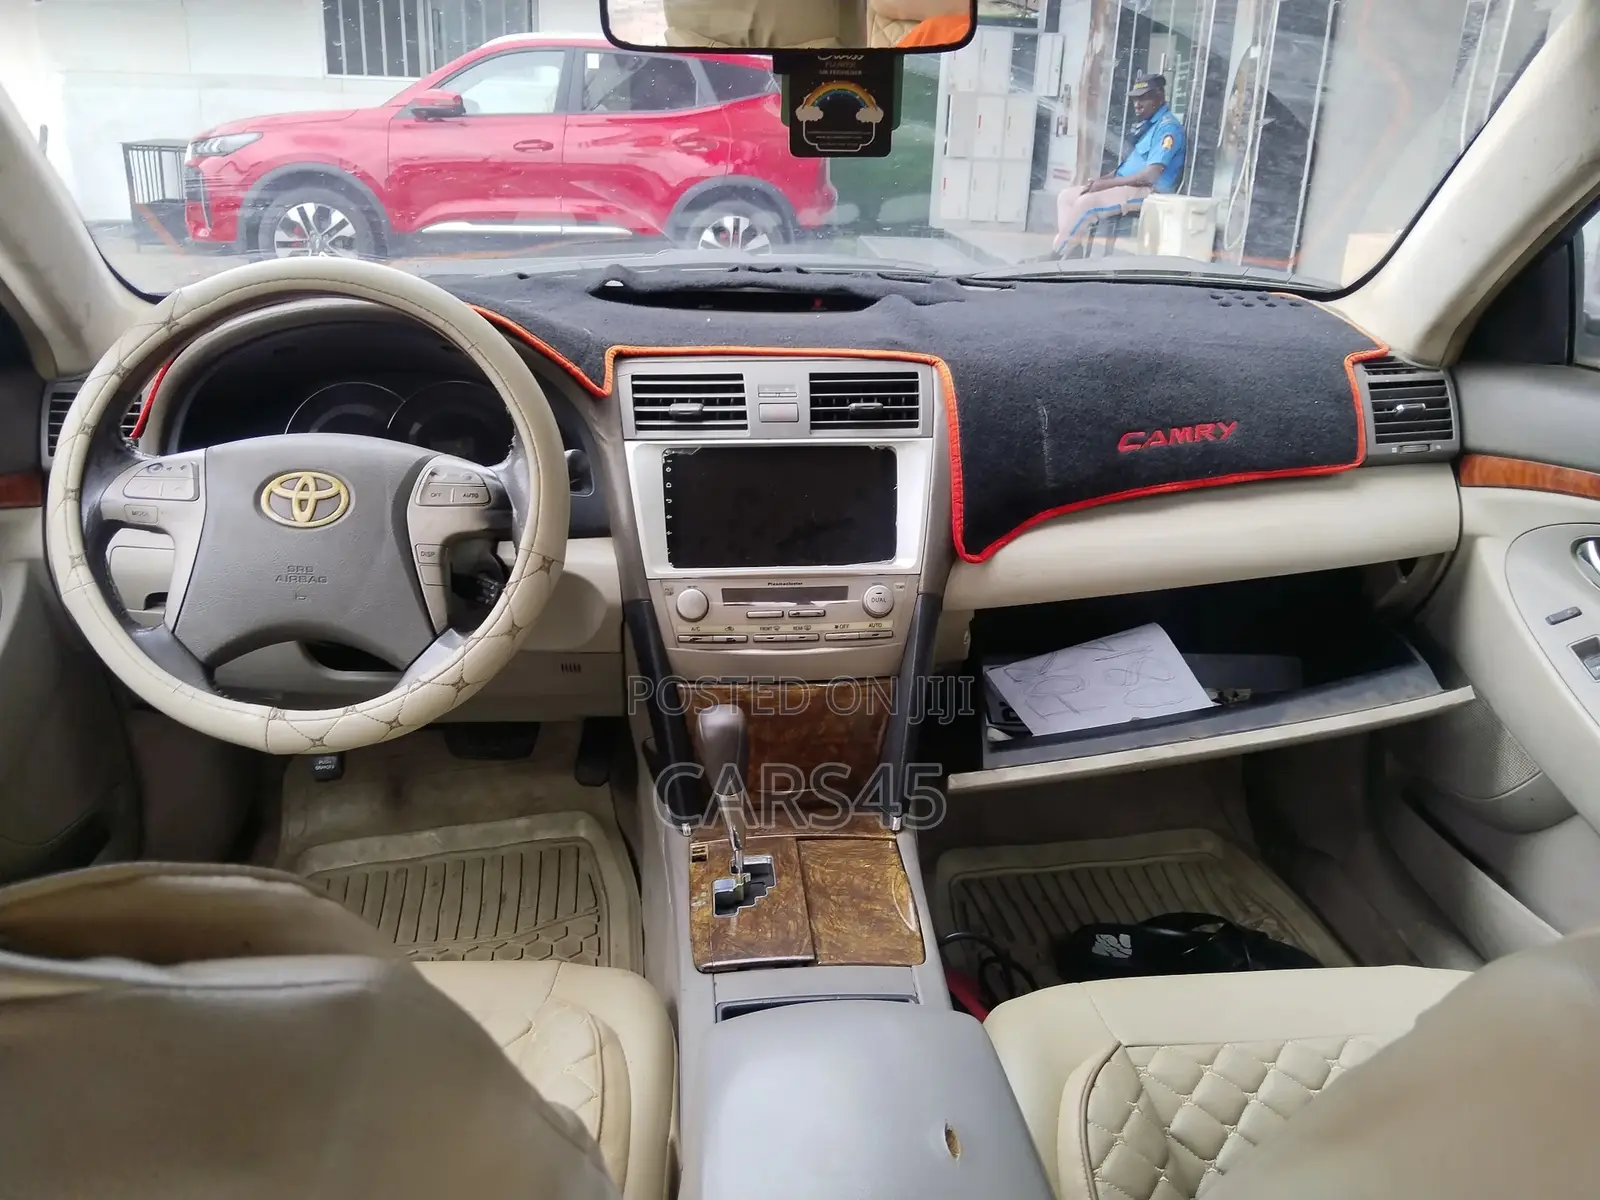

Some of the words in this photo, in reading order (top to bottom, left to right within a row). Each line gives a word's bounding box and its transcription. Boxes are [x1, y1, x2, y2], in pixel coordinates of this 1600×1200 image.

[1117, 421, 1238, 453] CAMRY
[420, 550, 436, 558] DISP
[287, 564, 314, 574] SRS
[274, 574, 329, 585] AIRBAG
